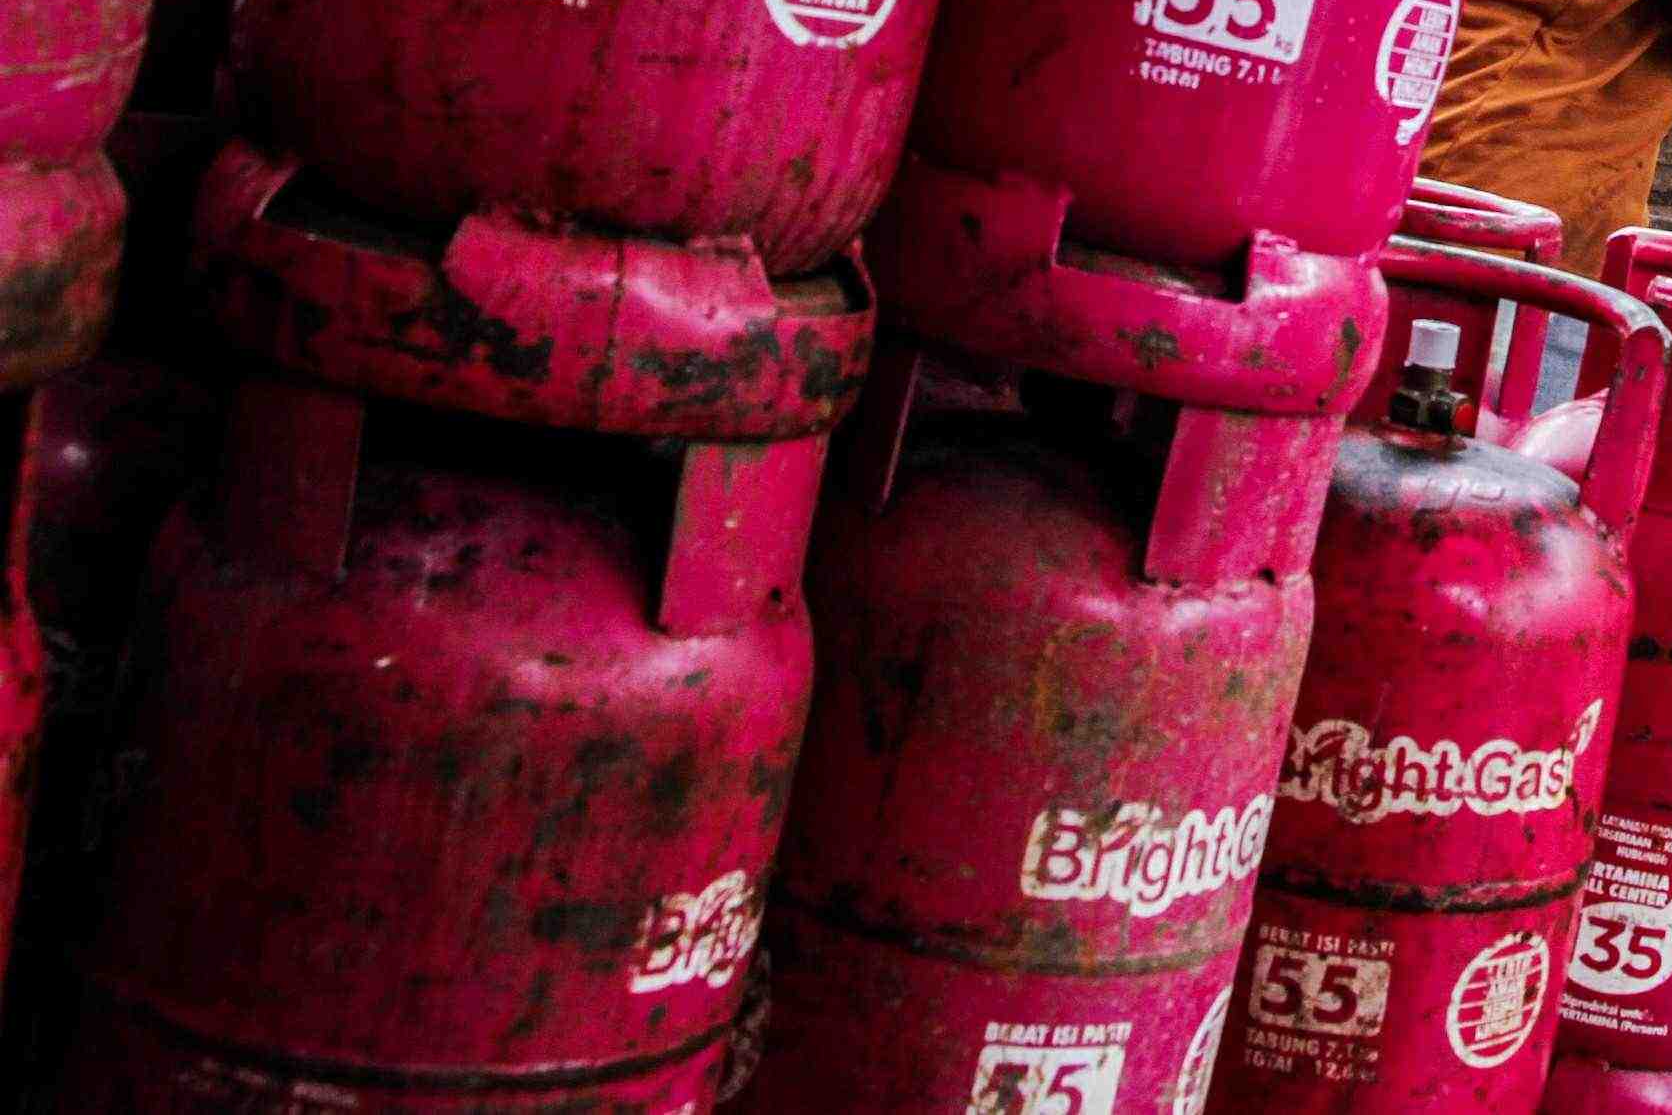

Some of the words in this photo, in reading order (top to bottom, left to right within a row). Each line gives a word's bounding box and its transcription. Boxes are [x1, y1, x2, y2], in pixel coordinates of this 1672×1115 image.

[1145, 38, 1232, 76] TABUNG
[1282, 719, 1463, 823] right
[1465, 740, 1574, 815] Gas
[1022, 802, 1234, 917] Bright
[1592, 861, 1670, 892] RTAMINA
[1609, 883, 1669, 908] CENTER
[1578, 915, 1667, 980] 35
